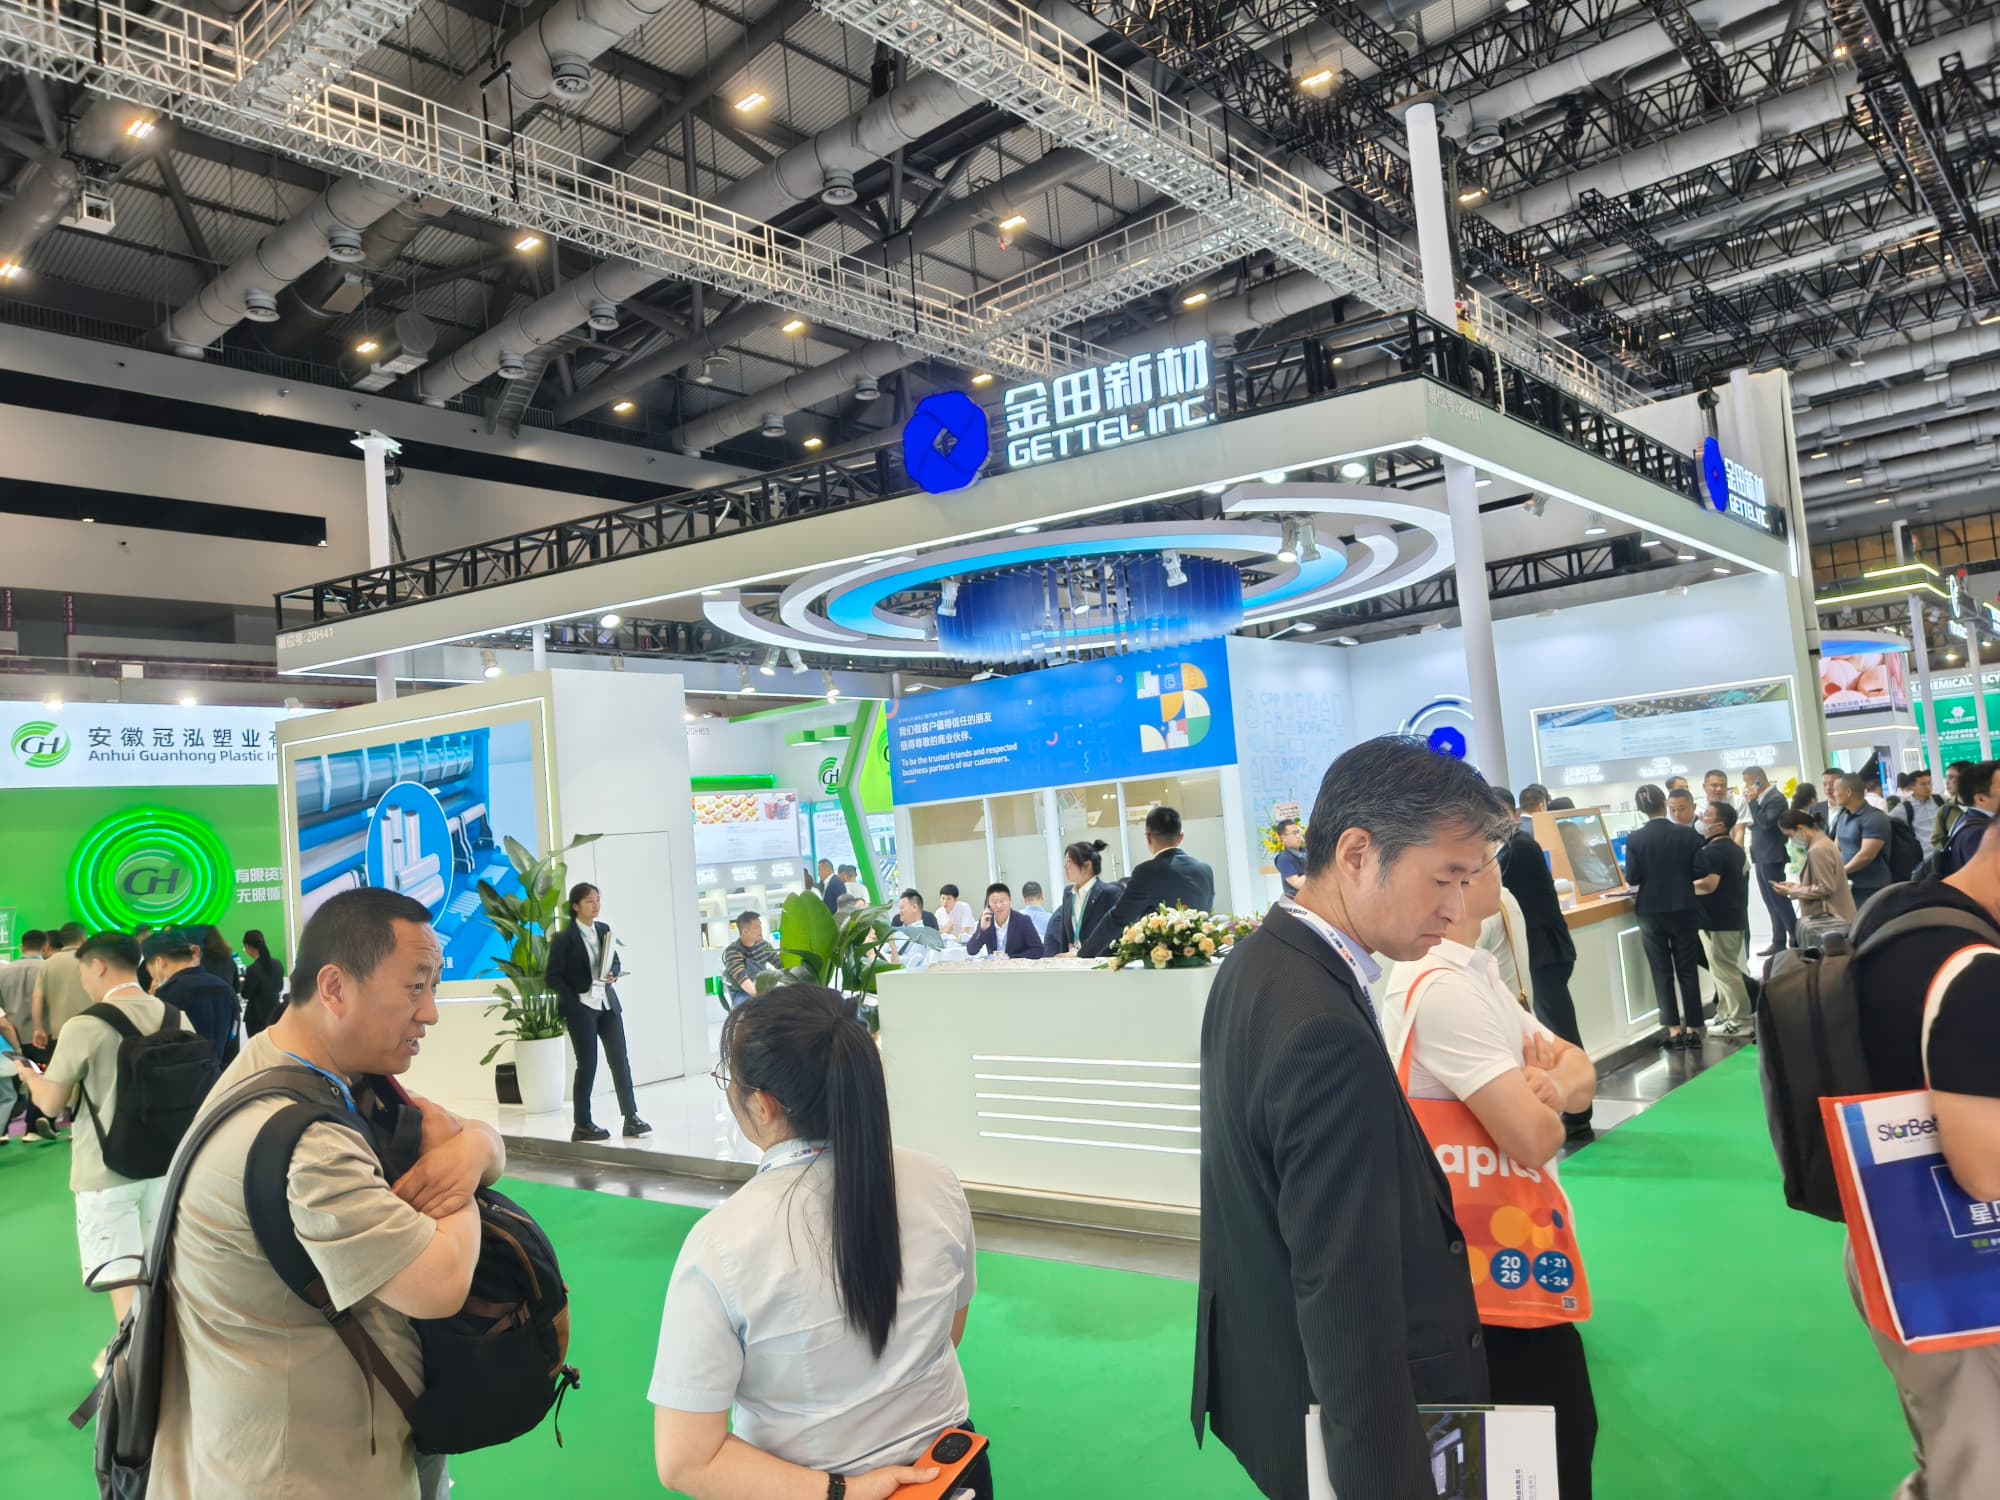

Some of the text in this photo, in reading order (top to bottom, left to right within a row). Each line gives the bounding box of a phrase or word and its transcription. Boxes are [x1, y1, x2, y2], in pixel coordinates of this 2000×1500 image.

[1004, 339, 1209, 438] 金田新材
[1007, 396, 1216, 467] GETTEL INC.
[88, 750, 135, 762] Anhui
[139, 750, 216, 764] Guanhong
[220, 750, 264, 762] Plastic
[918, 756, 928, 765] the
[928, 753, 950, 764] trusted
[950, 749, 972, 760] friends
[973, 747, 985, 756] and
[985, 742, 1018, 755] respected
[902, 767, 928, 777] business
[928, 763, 955, 775] partners
[955, 760, 961, 768] of
[962, 759, 973, 768] our
[235, 867, 282, 884] 有限资
[1500, 1256, 1521, 1269] 20
[1500, 1270, 1521, 1284] 26
